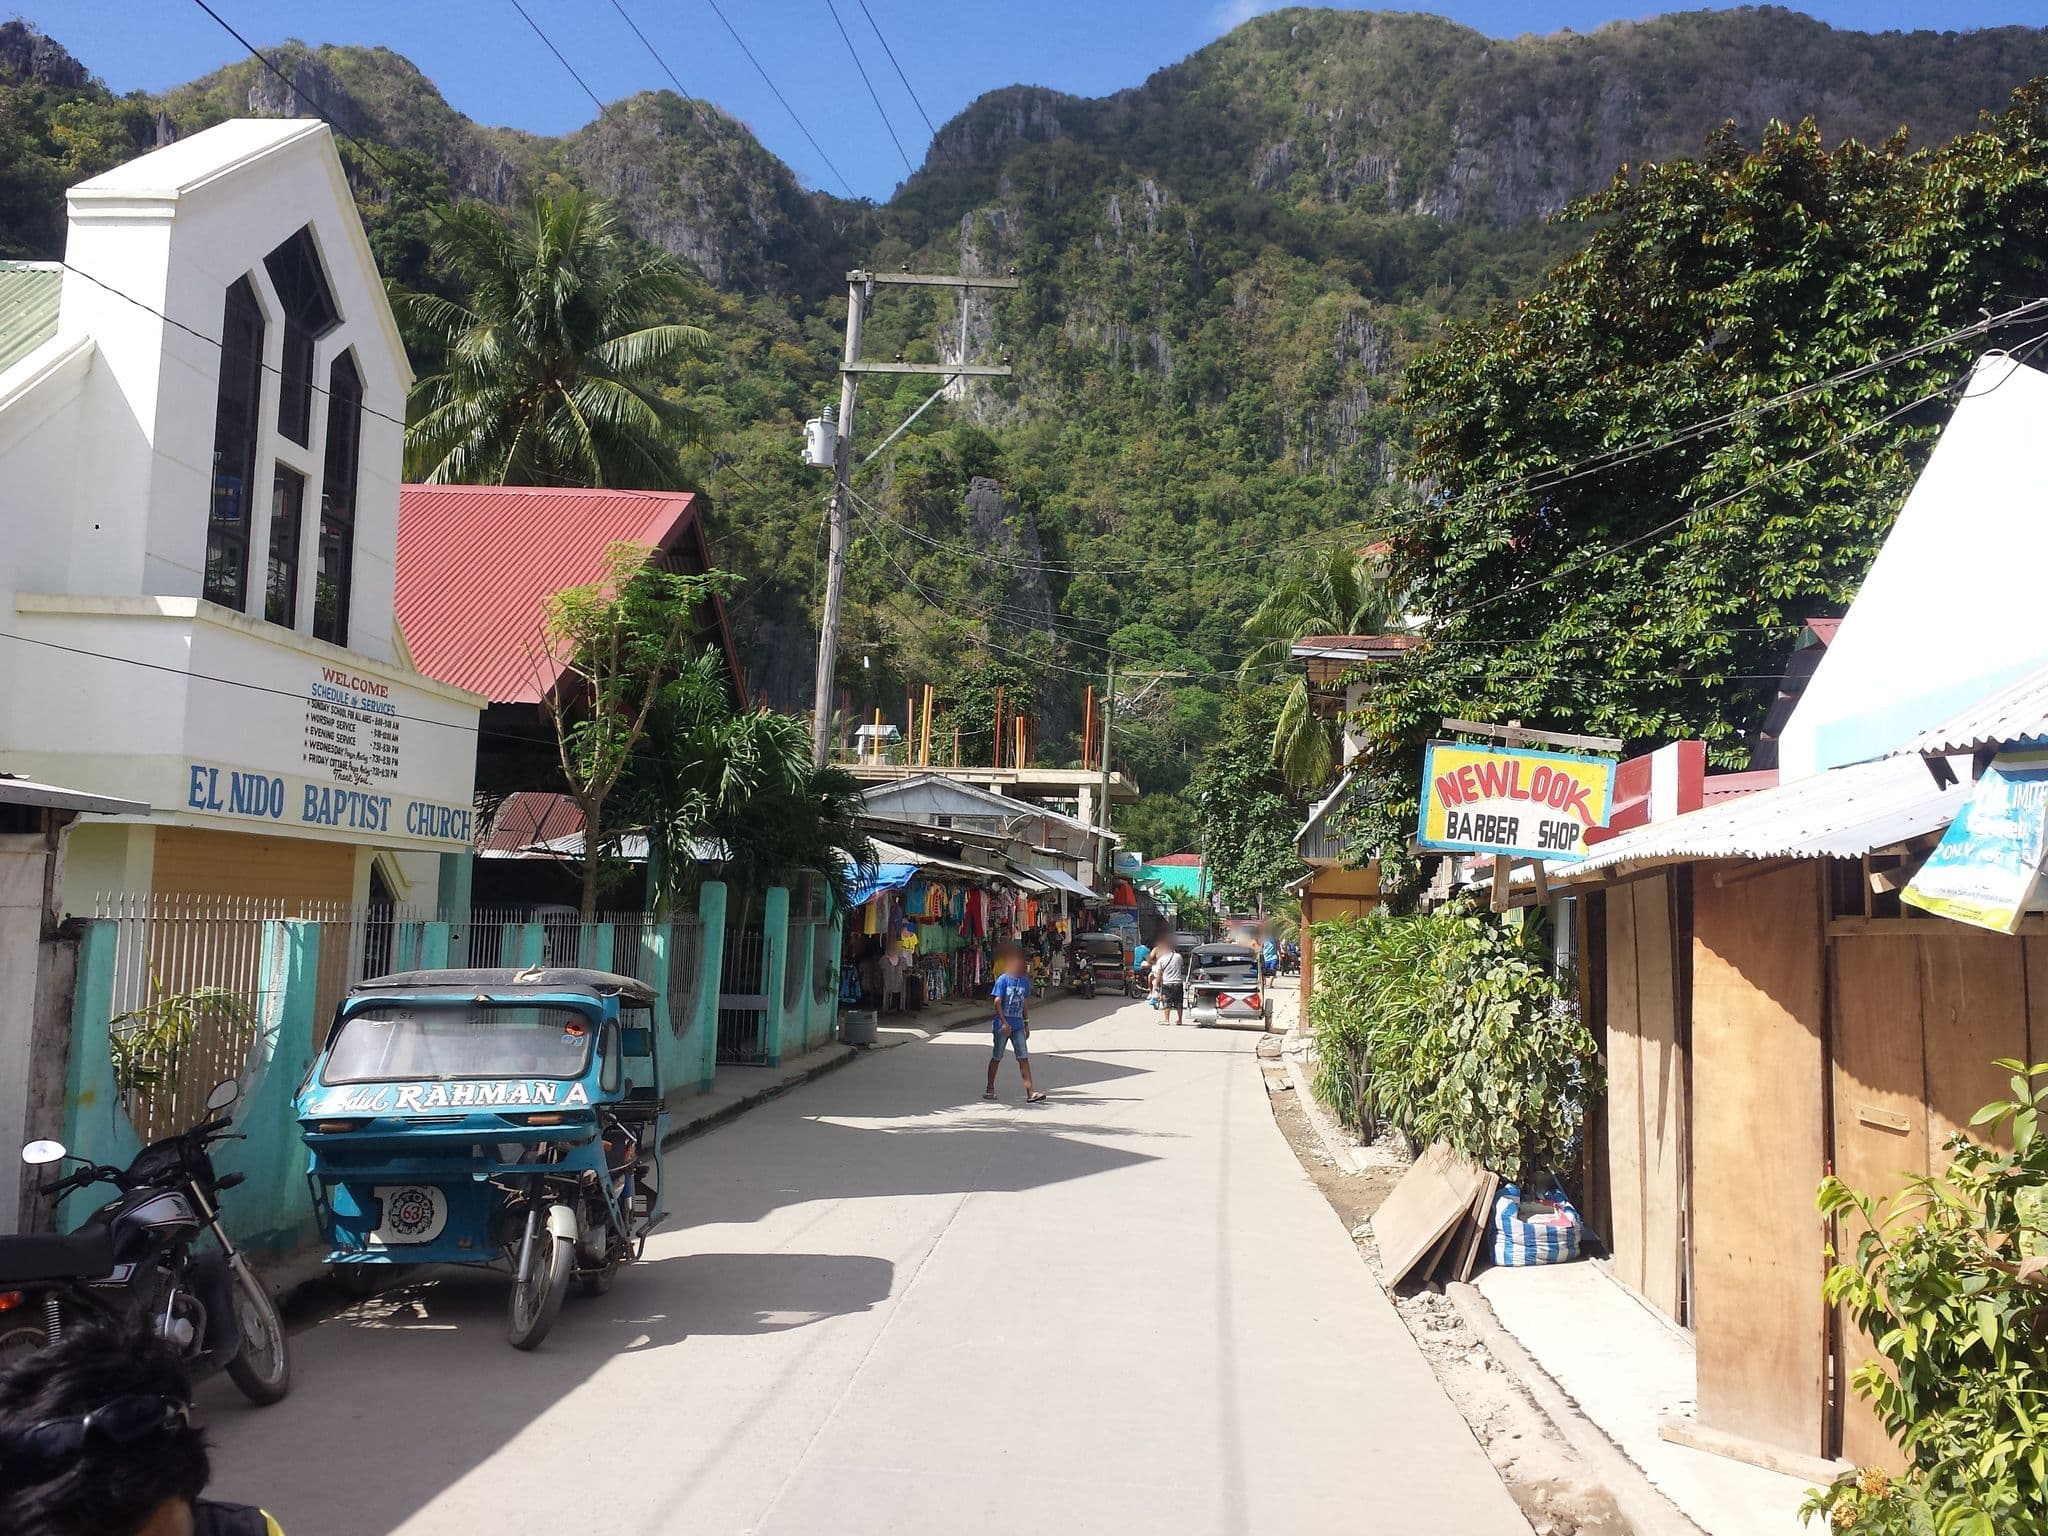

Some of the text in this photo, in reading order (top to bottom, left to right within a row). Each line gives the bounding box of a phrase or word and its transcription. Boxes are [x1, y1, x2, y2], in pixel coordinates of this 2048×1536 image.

[322, 667, 388, 698] WELCOME
[312, 683, 349, 704] SCHEDULE
[361, 698, 395, 715] SERVICES
[331, 705, 347, 719] SCHOOL
[311, 713, 335, 727] WORSHIP
[336, 720, 356, 733] SERVICE
[309, 740, 344, 756] WEDNESDAY
[391, 757, 399, 767] PM
[310, 726, 335, 740] EVENING
[336, 733, 356, 746] SERVICE
[392, 745, 399, 754] PM
[309, 753, 330, 766] FRIDAY
[390, 770, 398, 779] PM
[189, 765, 472, 841] EL NIDO BAPTIST CHURCH
[1446, 811, 1580, 850] BARBER SHOP
[396, 1081, 559, 1113] RAHMAN
[559, 1082, 589, 1107] A
